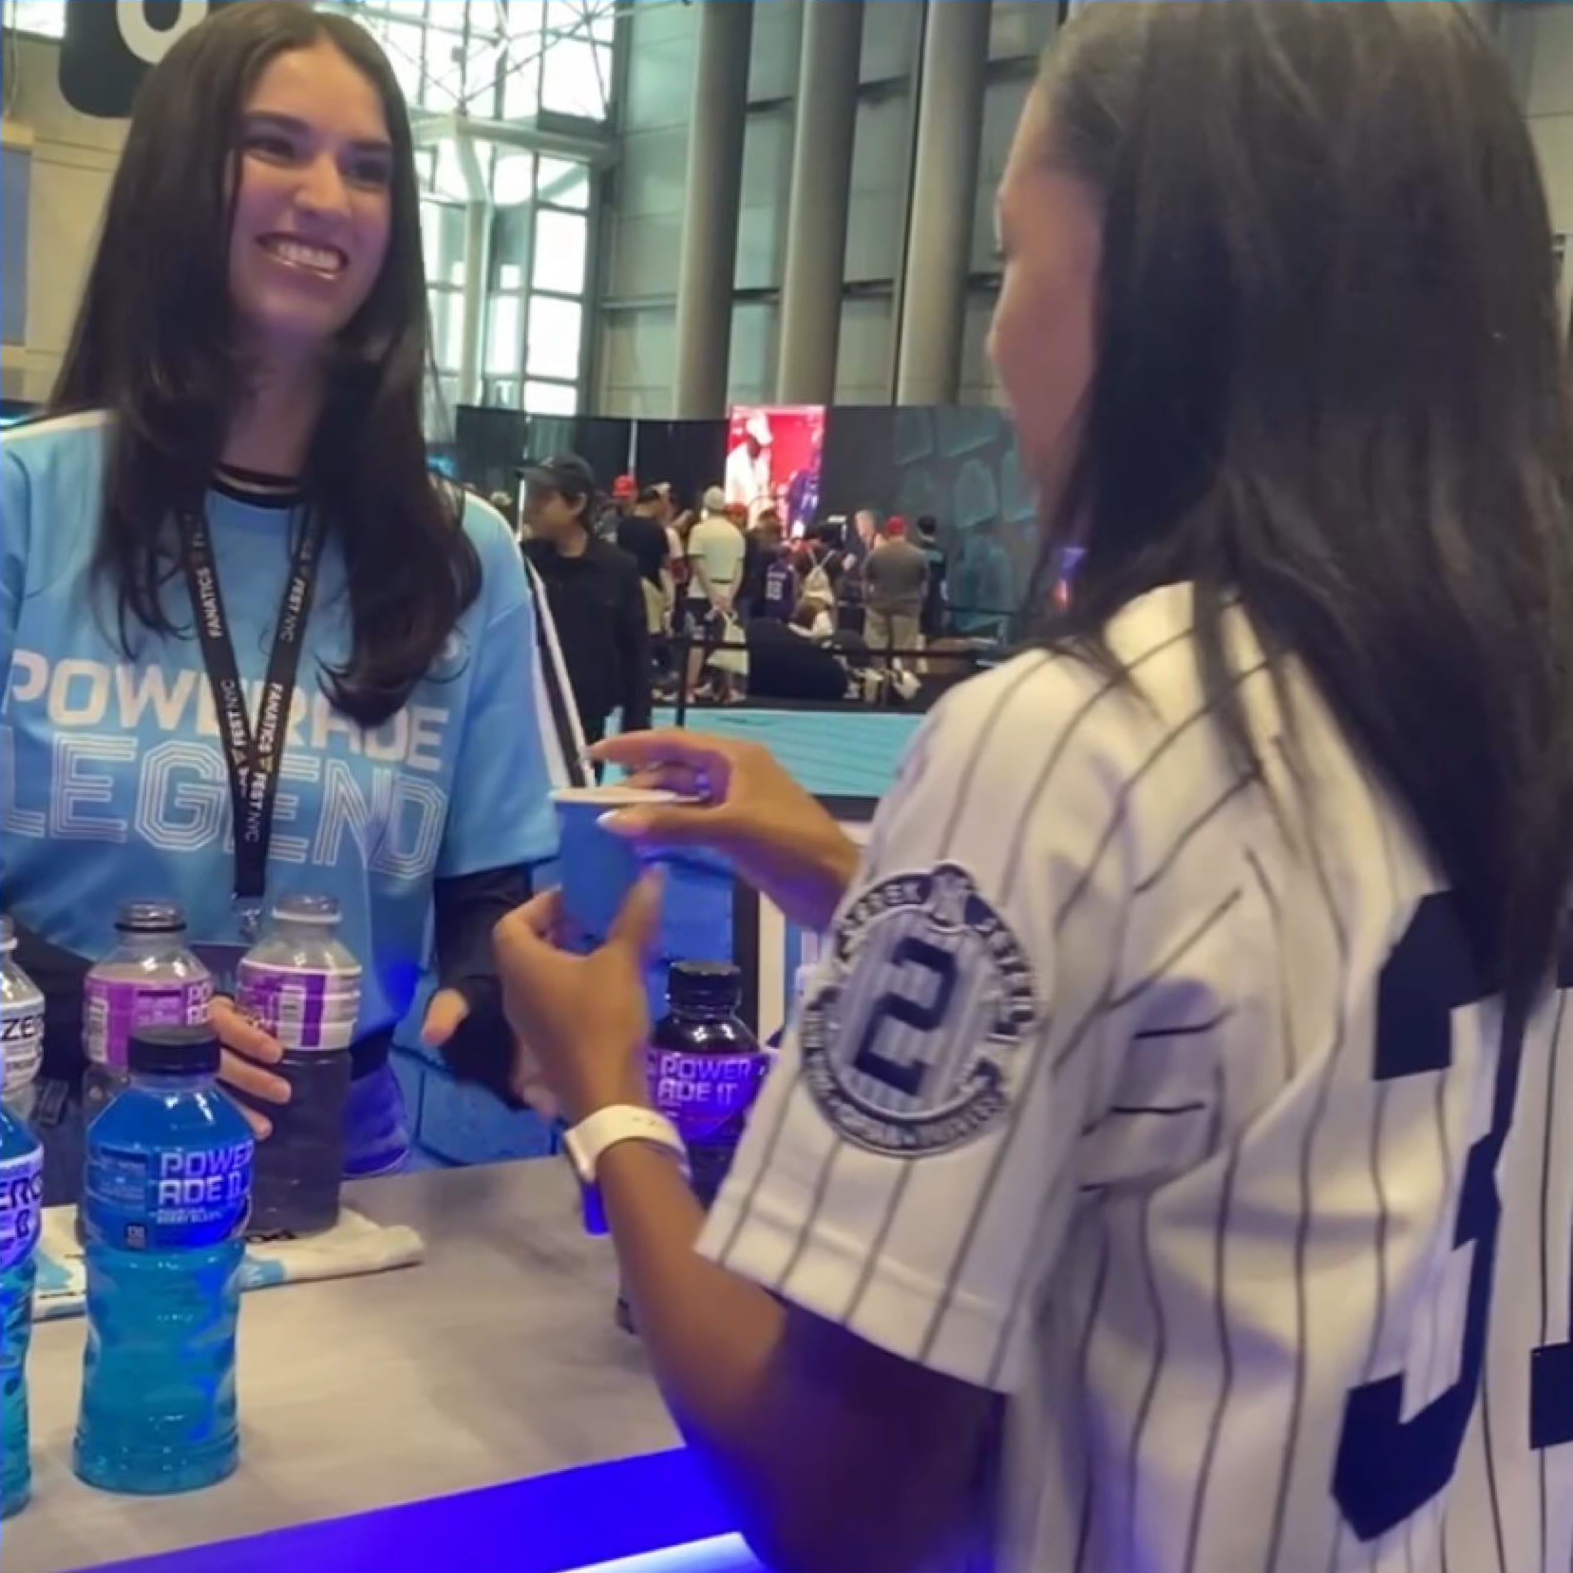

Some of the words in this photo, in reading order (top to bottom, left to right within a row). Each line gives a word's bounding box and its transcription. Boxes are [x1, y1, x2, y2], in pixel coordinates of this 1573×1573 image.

[853, 936, 959, 1098] 2
[660, 1054, 751, 1080] POWER
[657, 1077, 712, 1103] ADE
[158, 1175, 224, 1206] ADE
